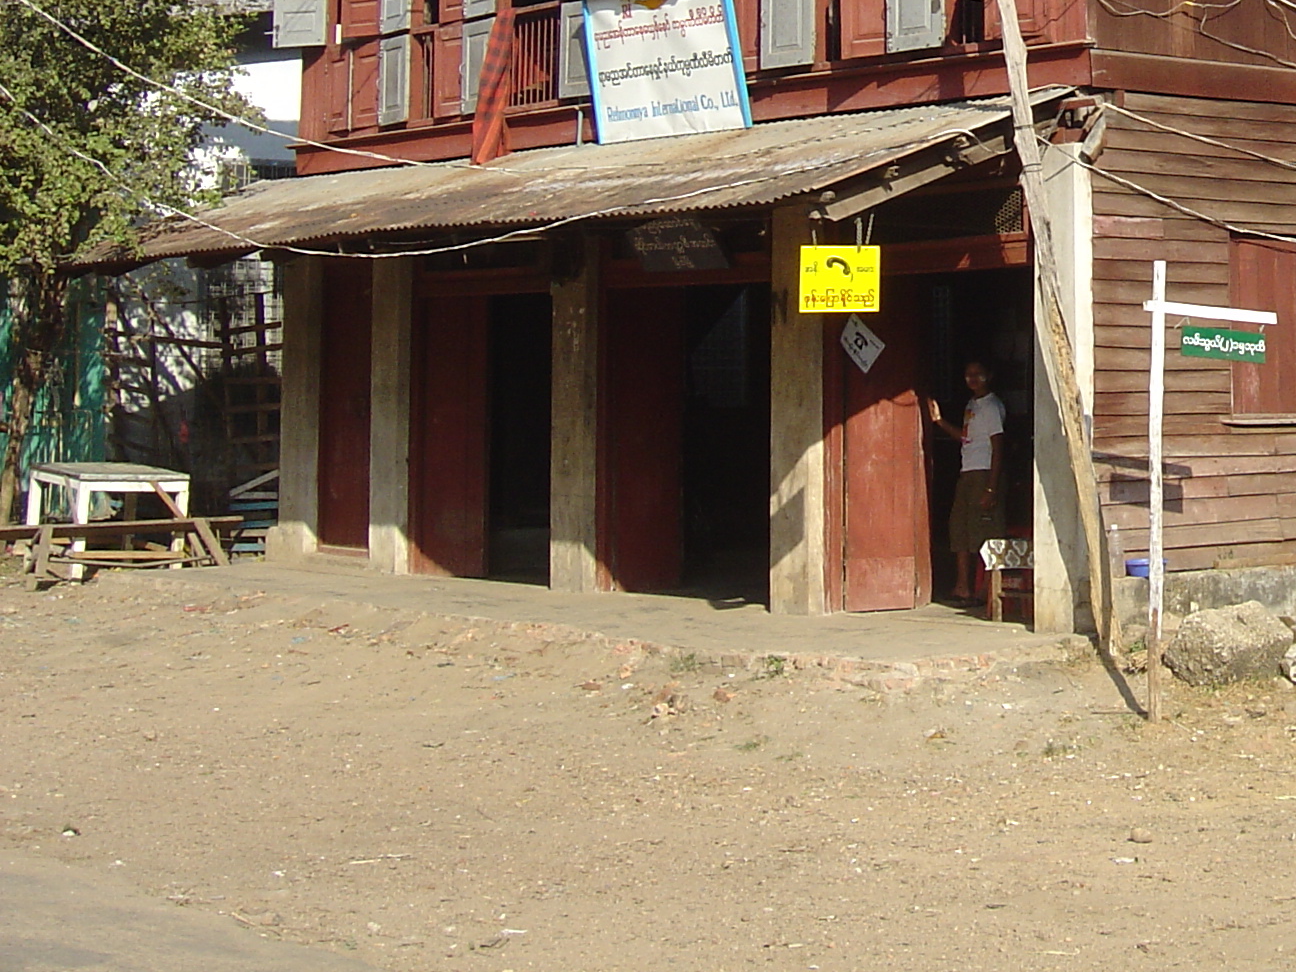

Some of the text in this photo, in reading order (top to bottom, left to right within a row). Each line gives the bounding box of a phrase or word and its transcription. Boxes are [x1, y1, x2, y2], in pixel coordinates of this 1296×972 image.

[651, 94, 700, 118] International
[700, 94, 719, 111] Co.,
[804, 289, 875, 308] ဖုန်းပြောနိုင်သည်
